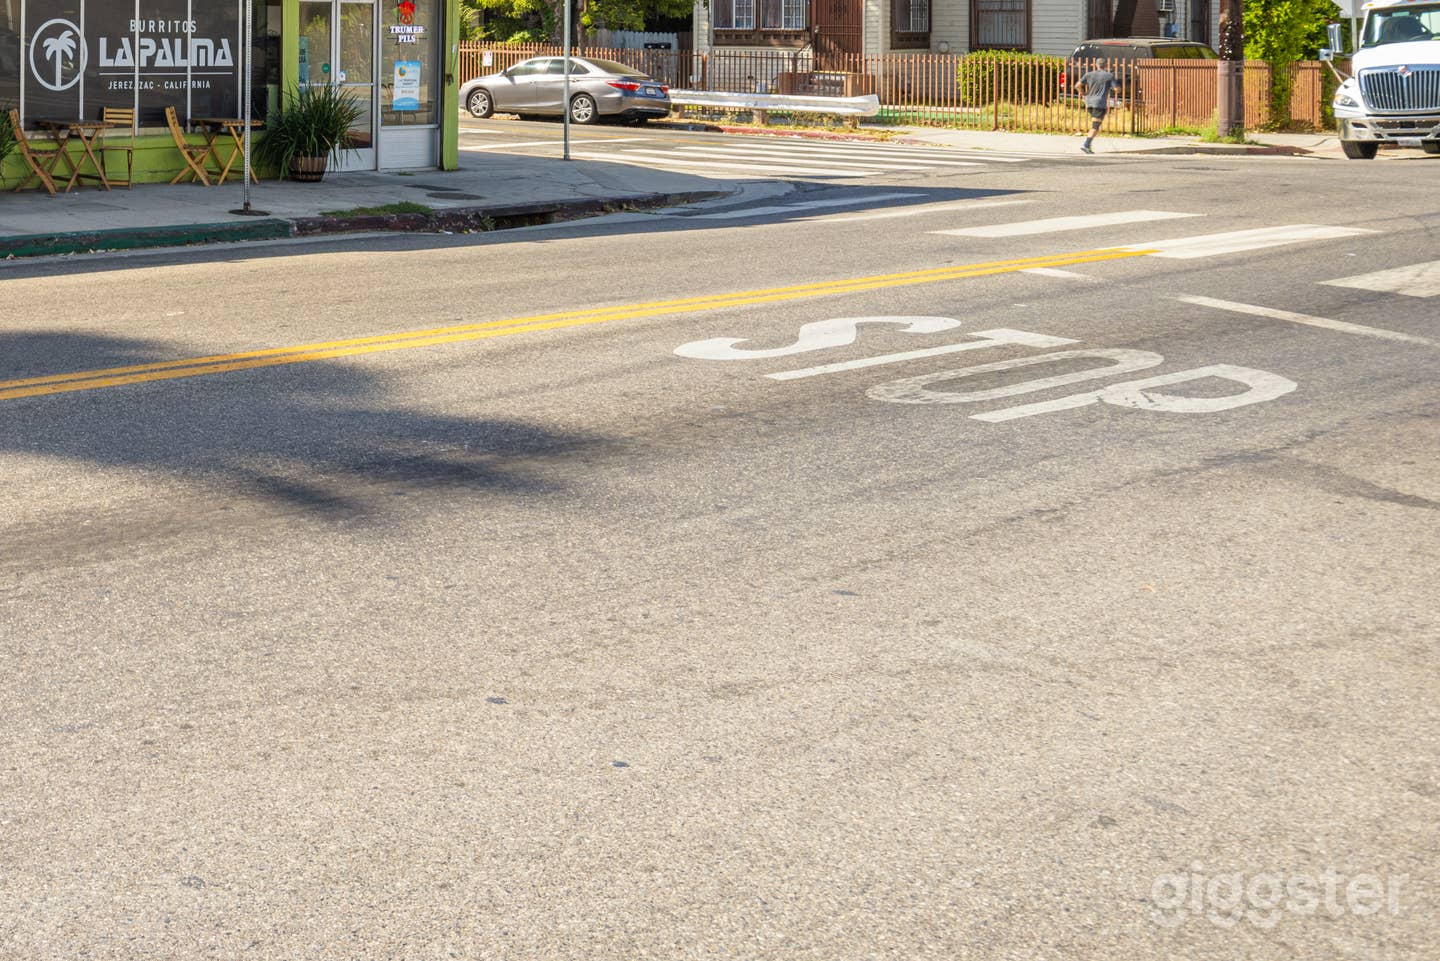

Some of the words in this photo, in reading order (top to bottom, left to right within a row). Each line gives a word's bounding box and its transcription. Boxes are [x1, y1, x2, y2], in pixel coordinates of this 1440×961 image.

[129, 19, 198, 33] BURRITOS
[389, 25, 425, 34] TRUMER
[398, 34, 416, 43] PILS
[140, 81, 154, 90] ZAC
[164, 80, 211, 90] CALIFRNIA
[673, 315, 1298, 423] STOP
